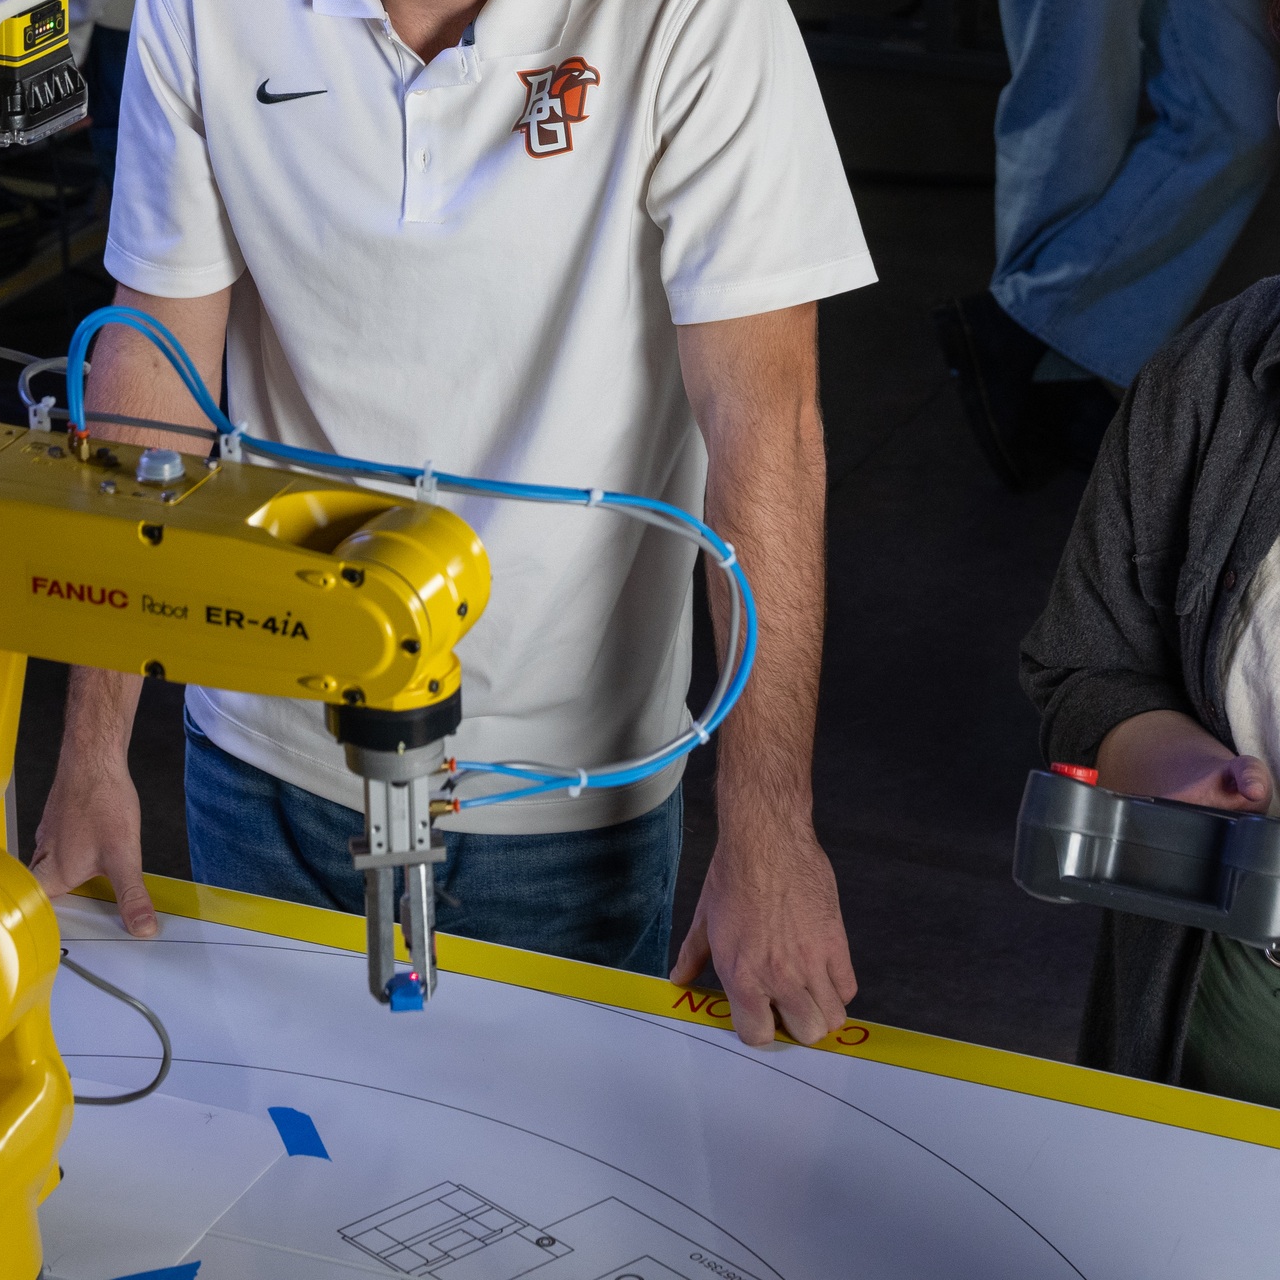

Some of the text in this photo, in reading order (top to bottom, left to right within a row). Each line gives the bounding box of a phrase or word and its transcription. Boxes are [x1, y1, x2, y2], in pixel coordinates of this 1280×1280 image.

[31, 576, 310, 641] FANUC Robot ER-4iA
